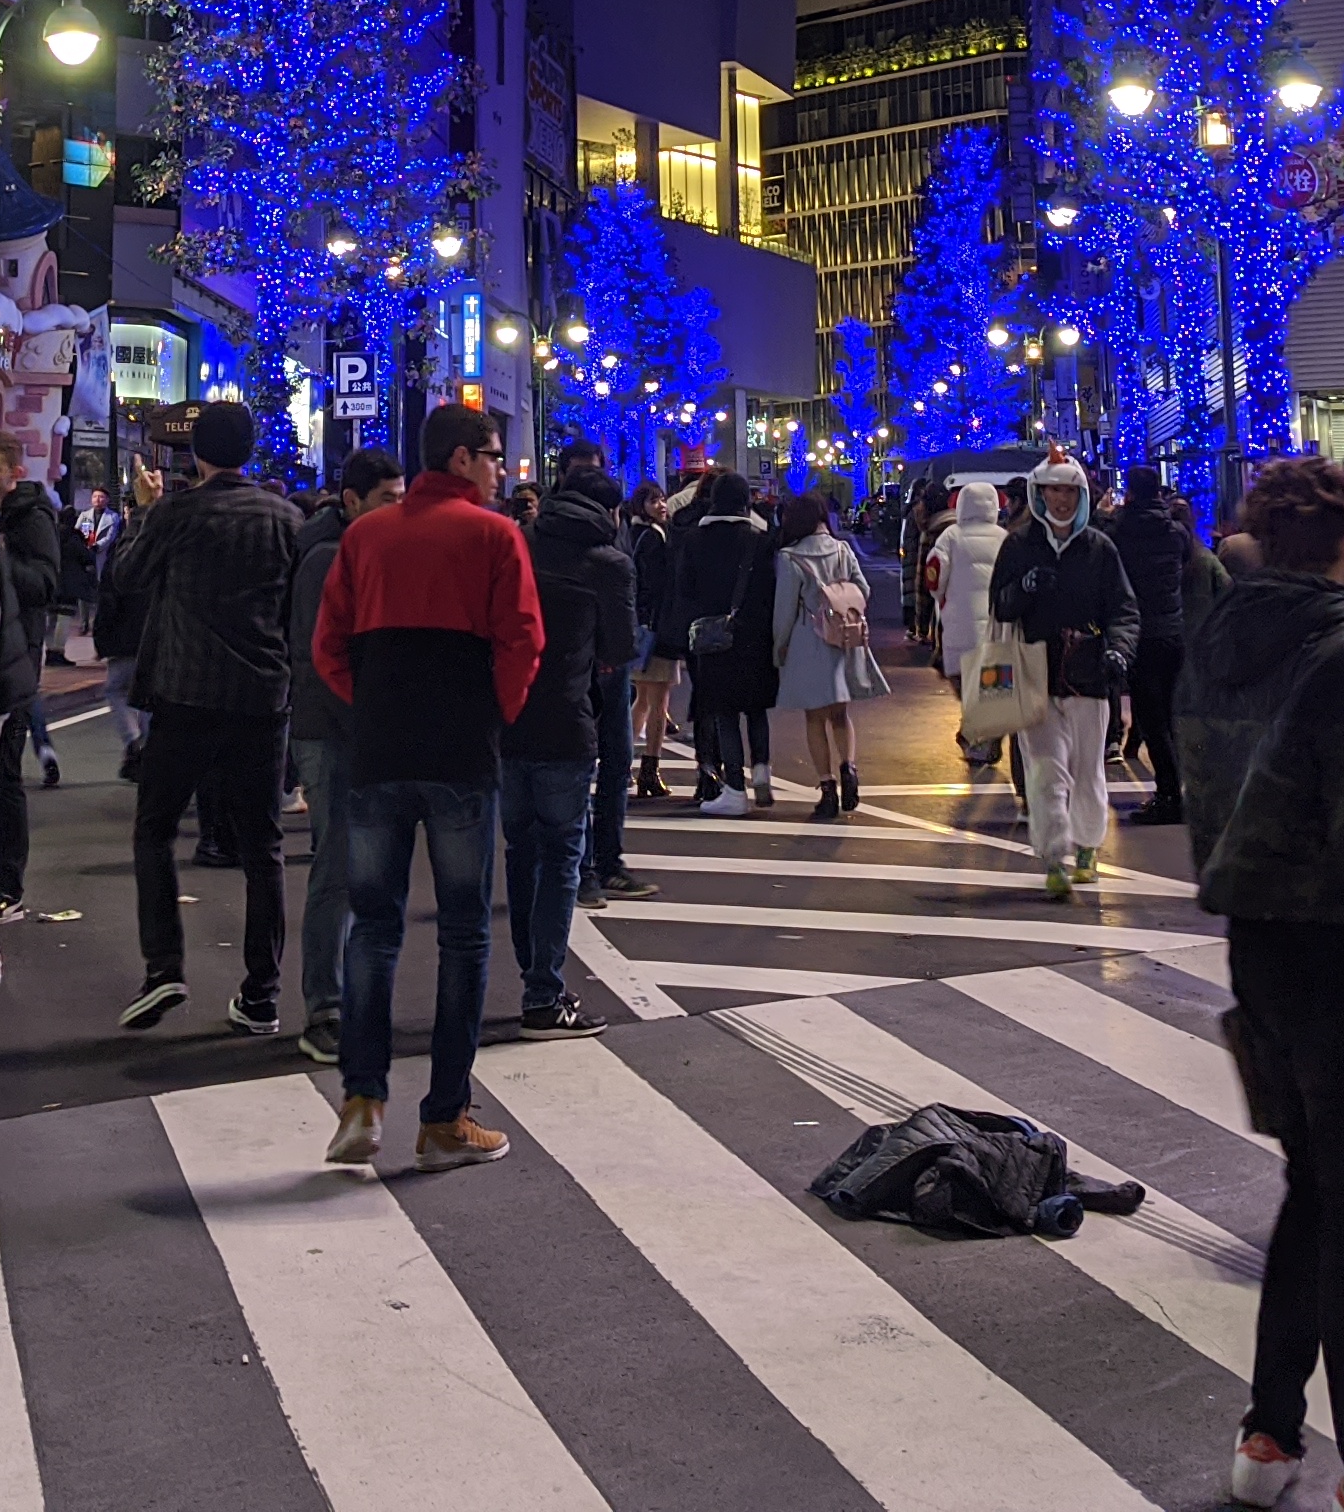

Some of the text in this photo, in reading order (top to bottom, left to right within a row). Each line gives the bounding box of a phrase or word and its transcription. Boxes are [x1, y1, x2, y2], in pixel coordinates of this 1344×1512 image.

[339, 357, 367, 393] P
[351, 381, 372, 392] 公共
[350, 402, 373, 411] 300m
